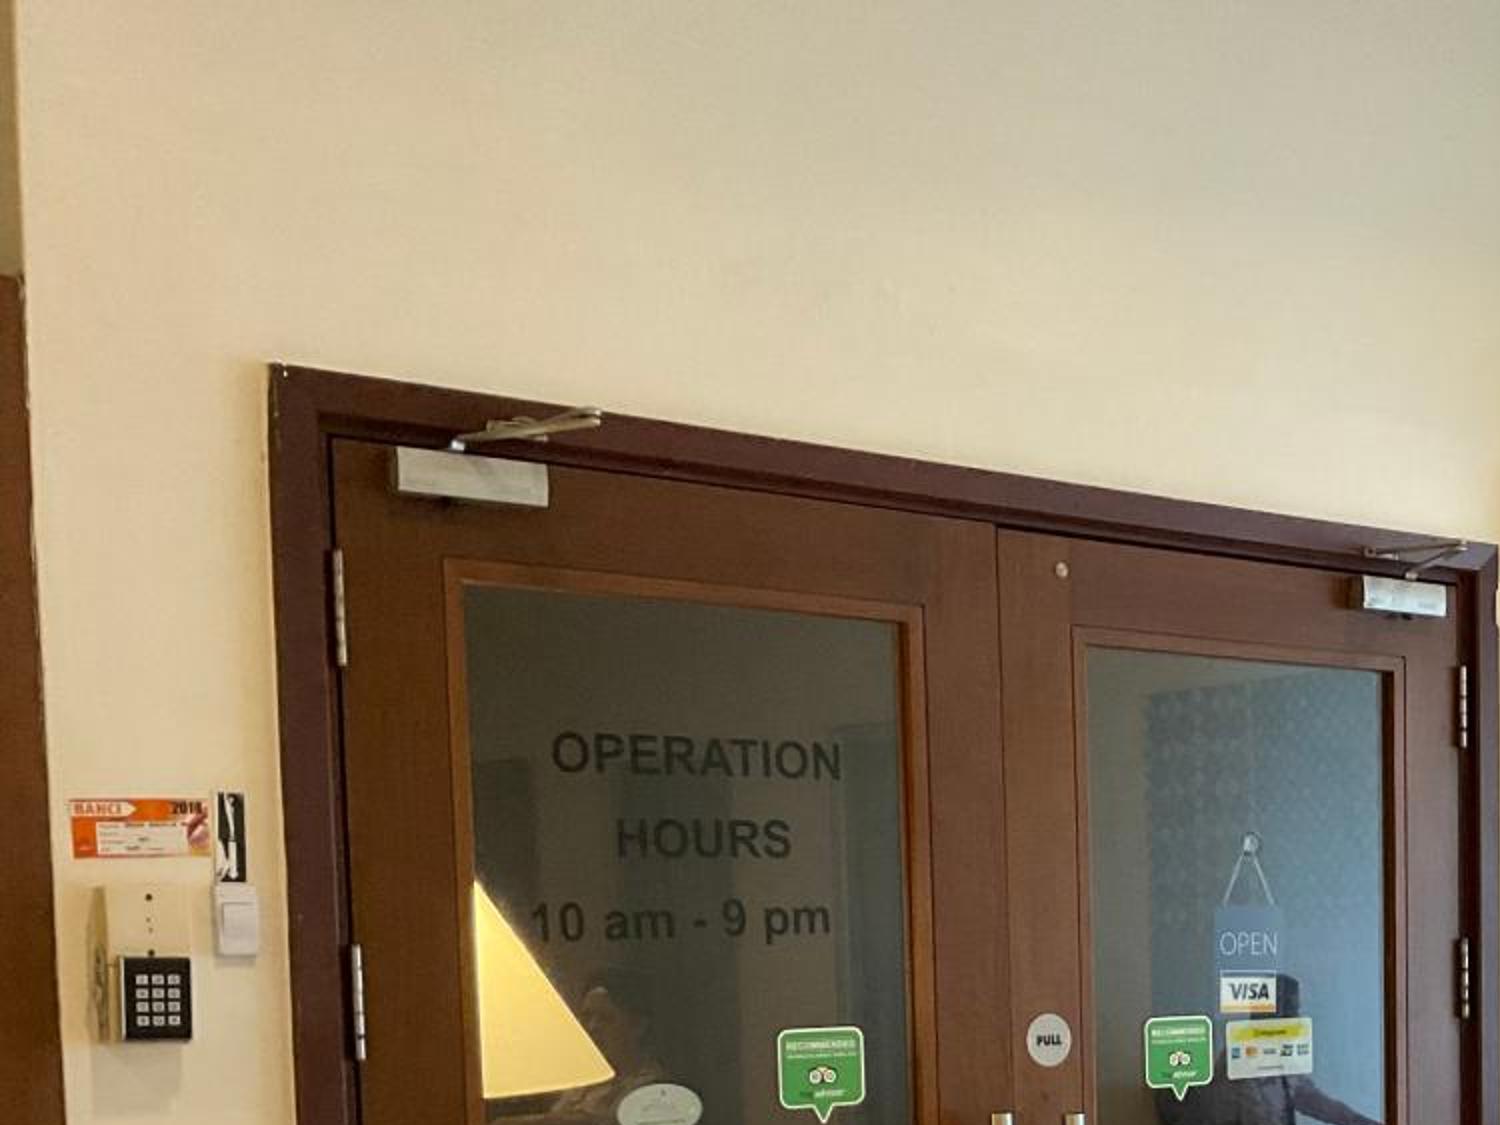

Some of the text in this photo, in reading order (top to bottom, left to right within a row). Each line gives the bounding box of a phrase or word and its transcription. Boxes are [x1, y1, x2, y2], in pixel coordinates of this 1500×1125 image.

[551, 731, 842, 781] OPERATION
[615, 818, 792, 859] HOURS
[530, 902, 585, 943] 10
[604, 908, 676, 942] am
[721, 898, 747, 937] 9
[763, 904, 831, 945] pm
[1219, 931, 1279, 956] OPEN
[1228, 982, 1270, 1001] VISA
[1036, 1034, 1063, 1046] PULL
